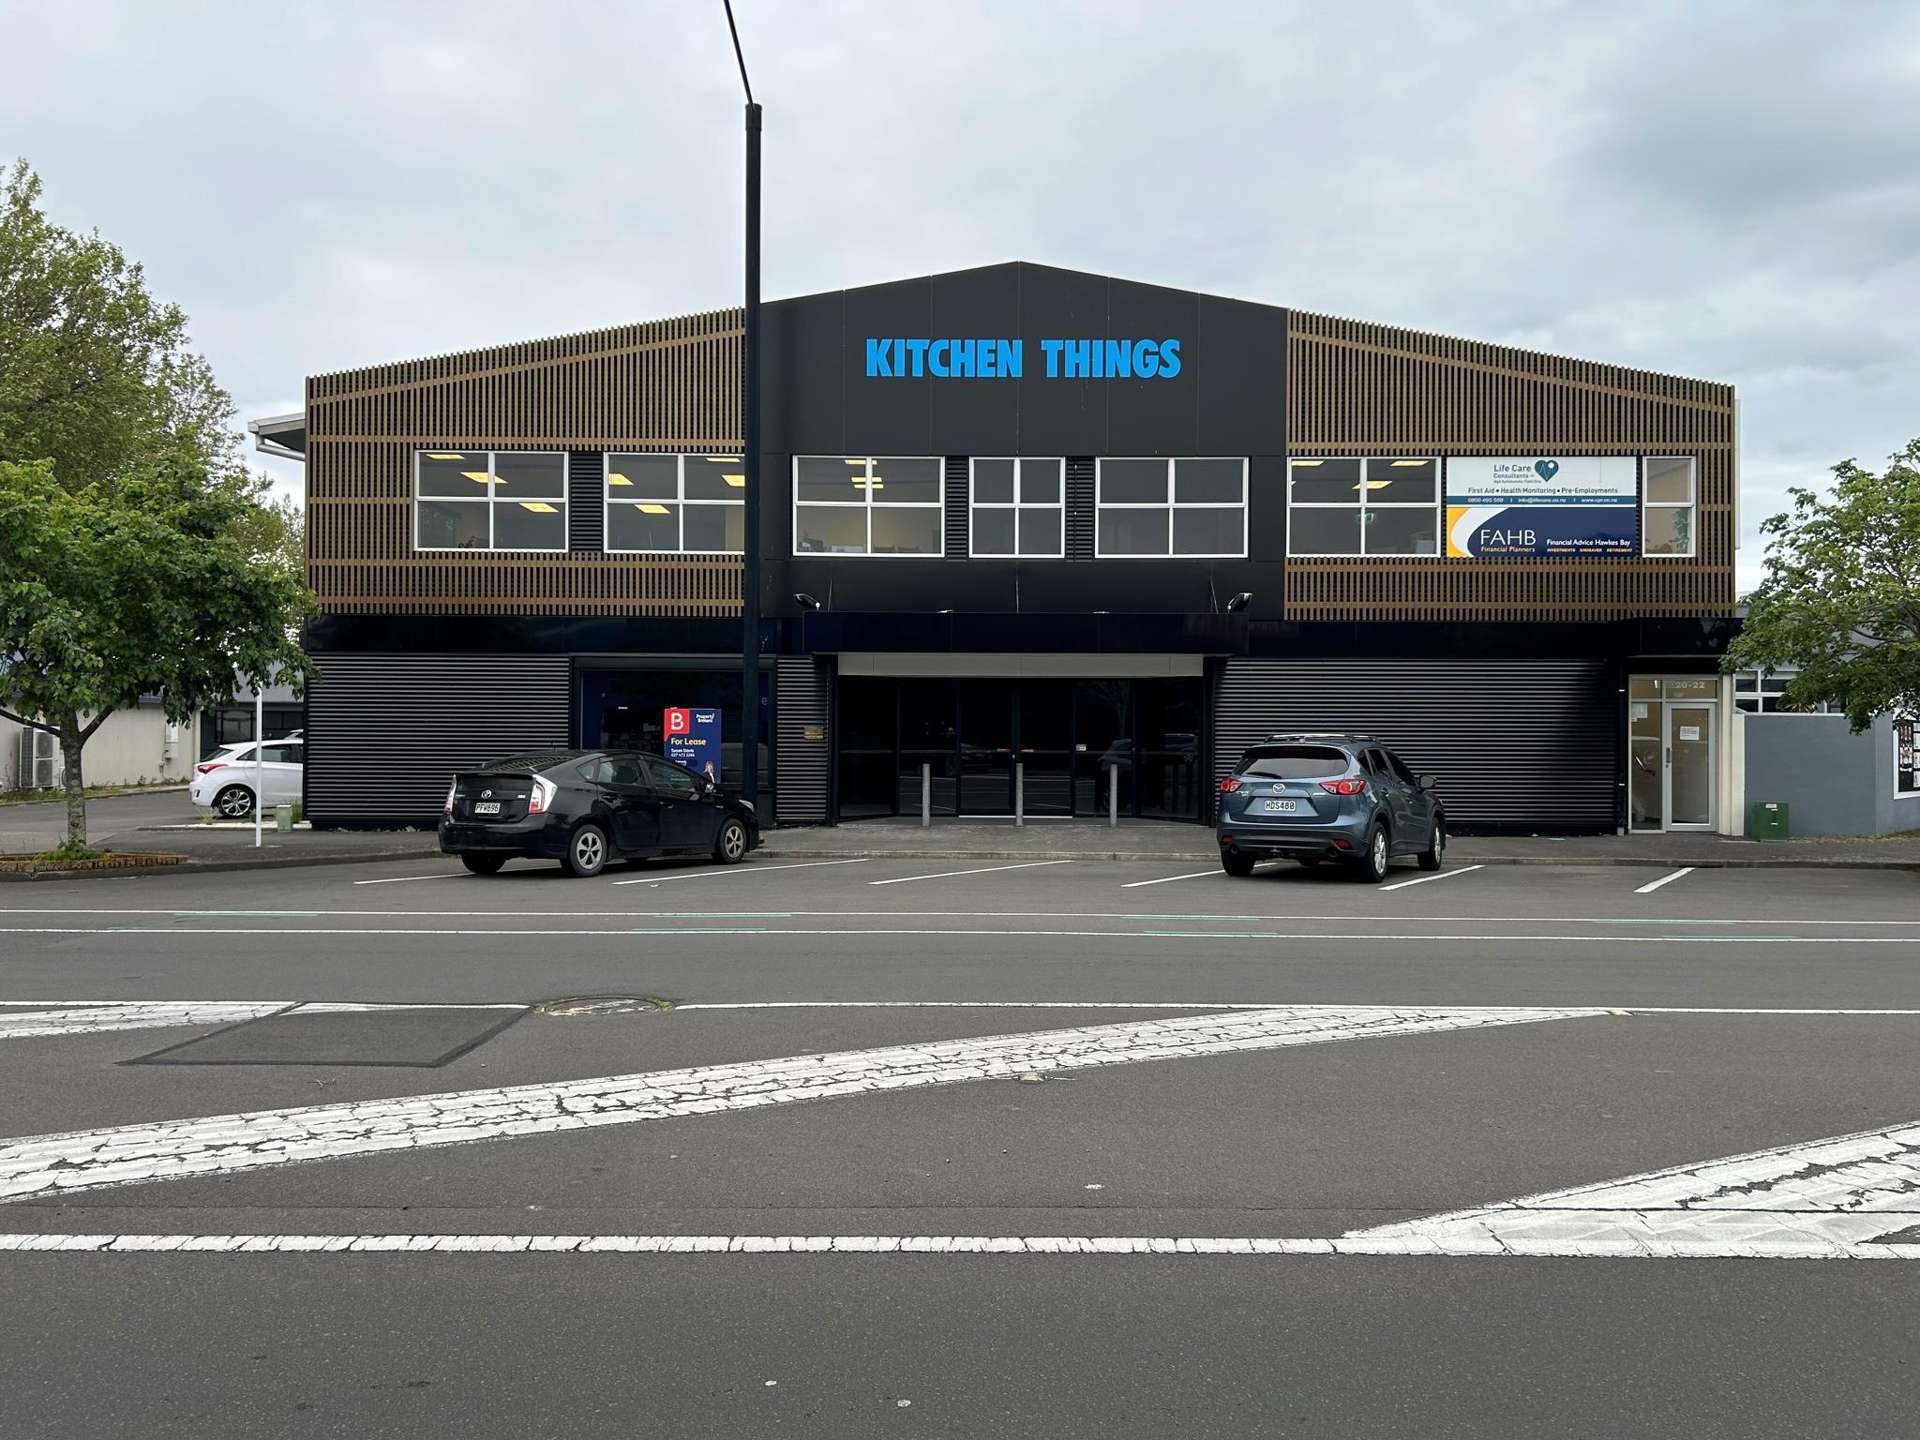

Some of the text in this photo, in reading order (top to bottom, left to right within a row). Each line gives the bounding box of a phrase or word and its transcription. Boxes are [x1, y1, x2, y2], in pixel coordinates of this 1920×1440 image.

[866, 338, 1181, 379] KITCHEN THINGS
[1493, 464, 1532, 473] Life Care
[1522, 487, 1557, 495] Monitoring
[1561, 487, 1618, 495] Pre-Employments
[1480, 529, 1536, 546] FAHB
[1547, 538, 1631, 547] Financial Advice Hawkes Bay
[671, 712, 684, 730] B
[671, 738, 706, 746] For Lease
